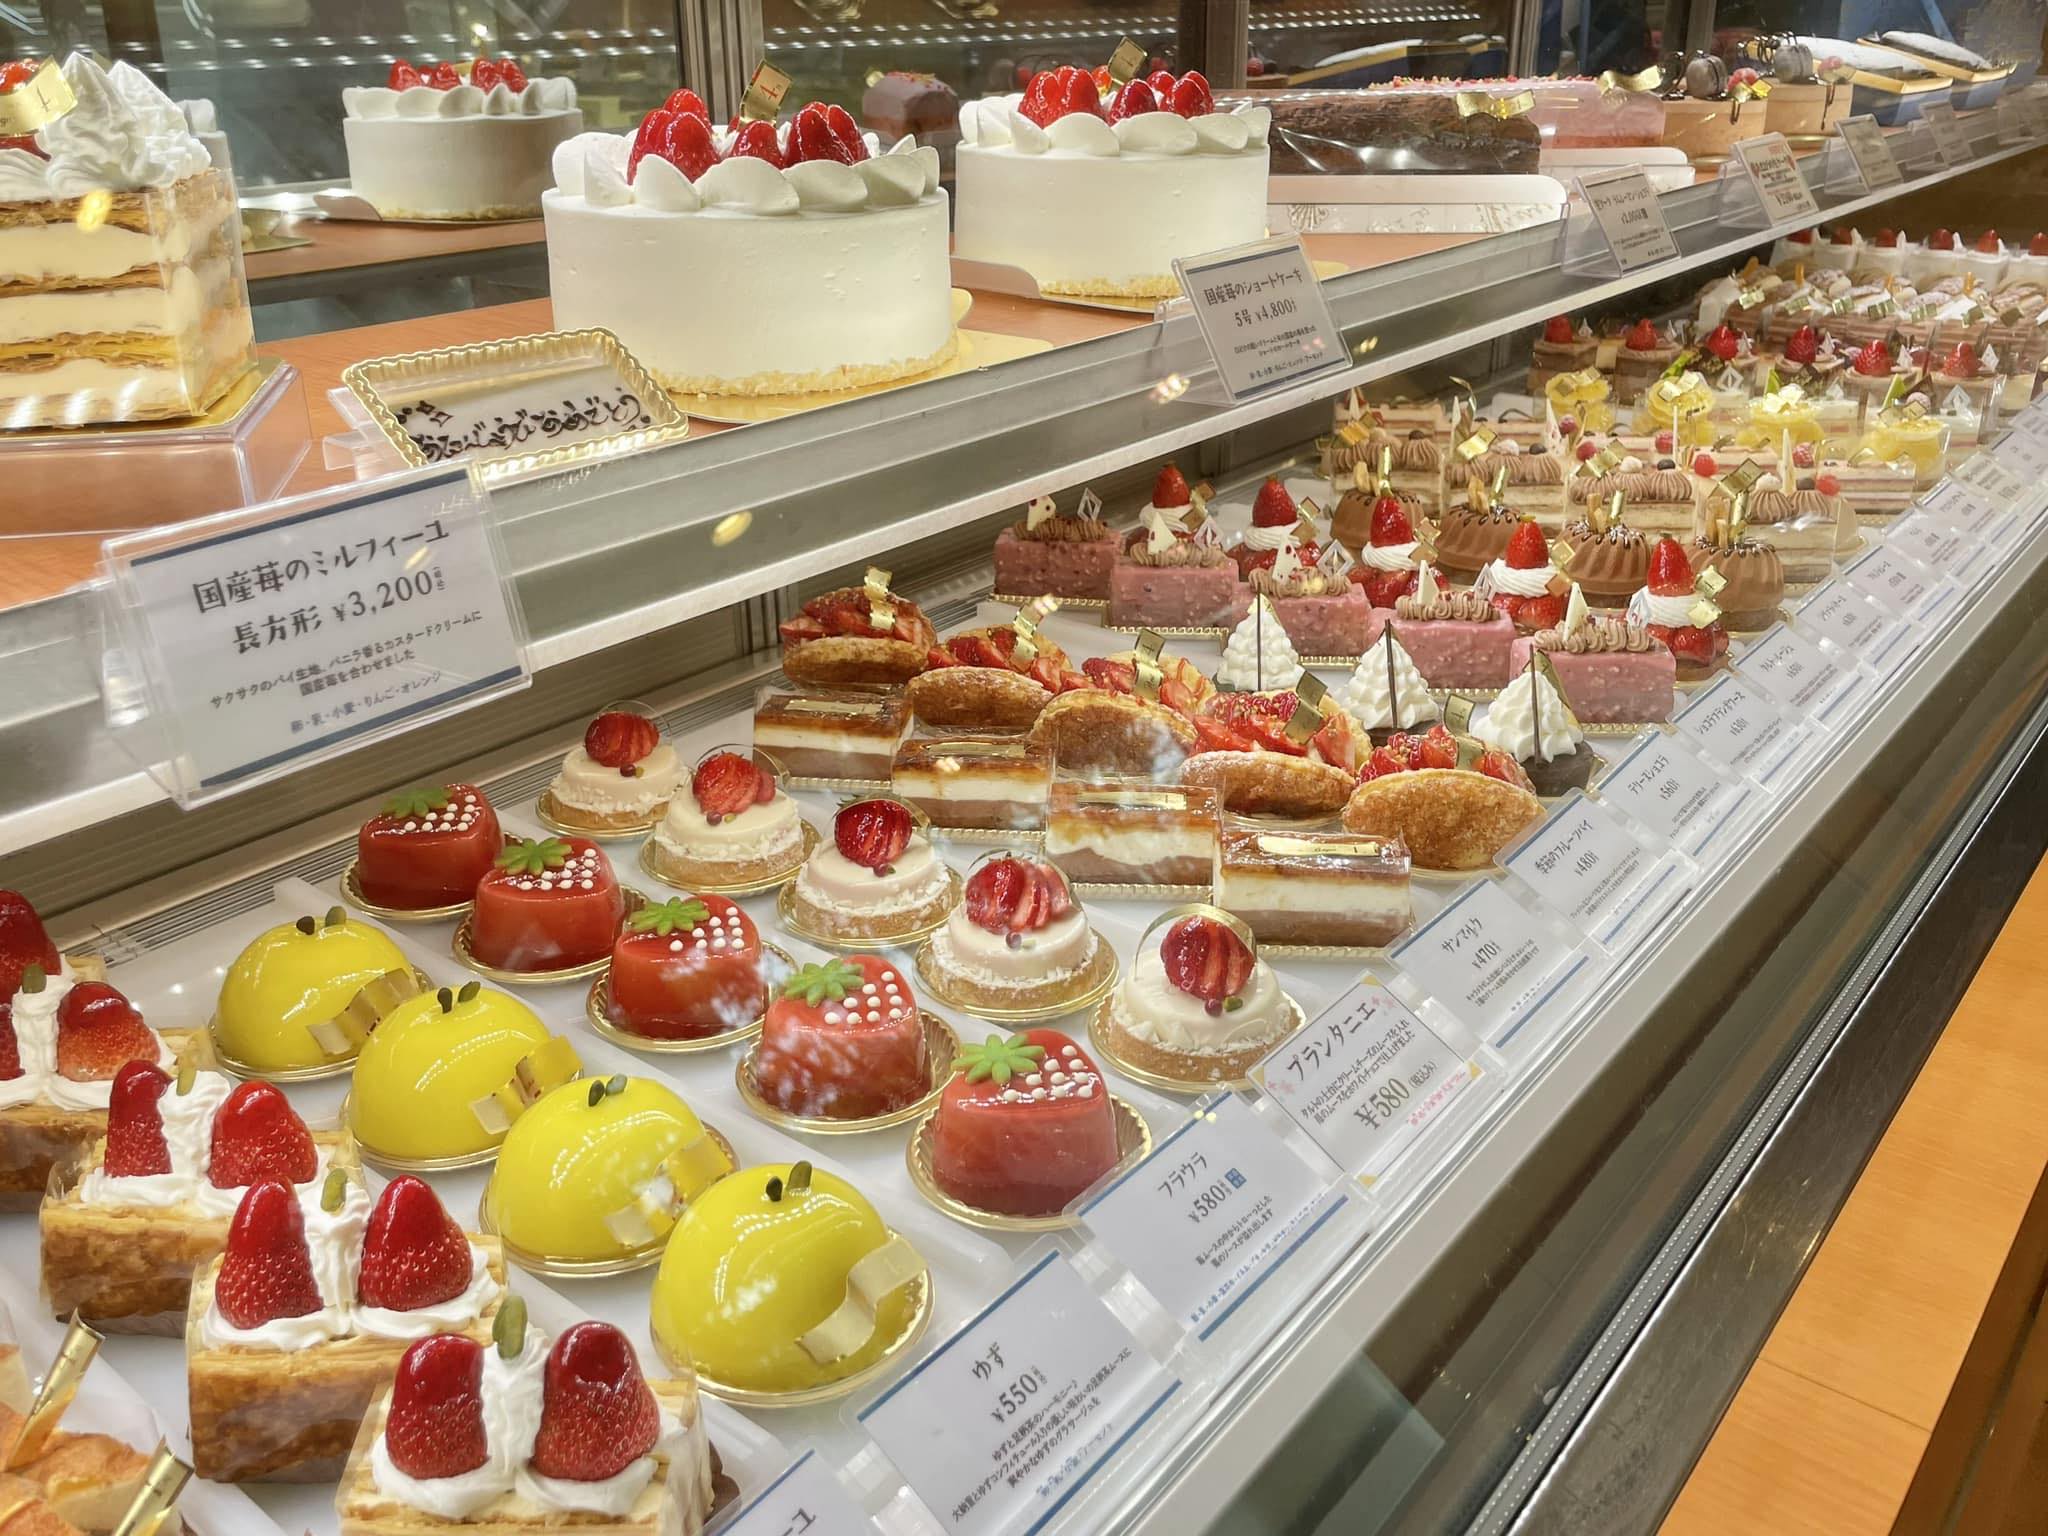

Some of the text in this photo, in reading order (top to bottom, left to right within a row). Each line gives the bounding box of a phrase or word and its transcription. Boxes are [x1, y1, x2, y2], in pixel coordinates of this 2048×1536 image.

[192, 519, 450, 614] 国産苺のミルフィーユ
[233, 605, 323, 655] 長方形
[332, 570, 433, 622] ¥3,200
[1574, 852, 1597, 877] ¥480
[1441, 917, 1483, 953] サンマルク
[1471, 943, 1498, 969] ¥470
[1286, 1002, 1377, 1081] プランタニエ
[1353, 1078, 1410, 1131] ¥580
[1157, 1151, 1208, 1198] フラウラ
[1188, 1184, 1226, 1224] ¥580
[971, 1341, 1004, 1381] ゆず
[991, 1373, 1038, 1423] ¥550
